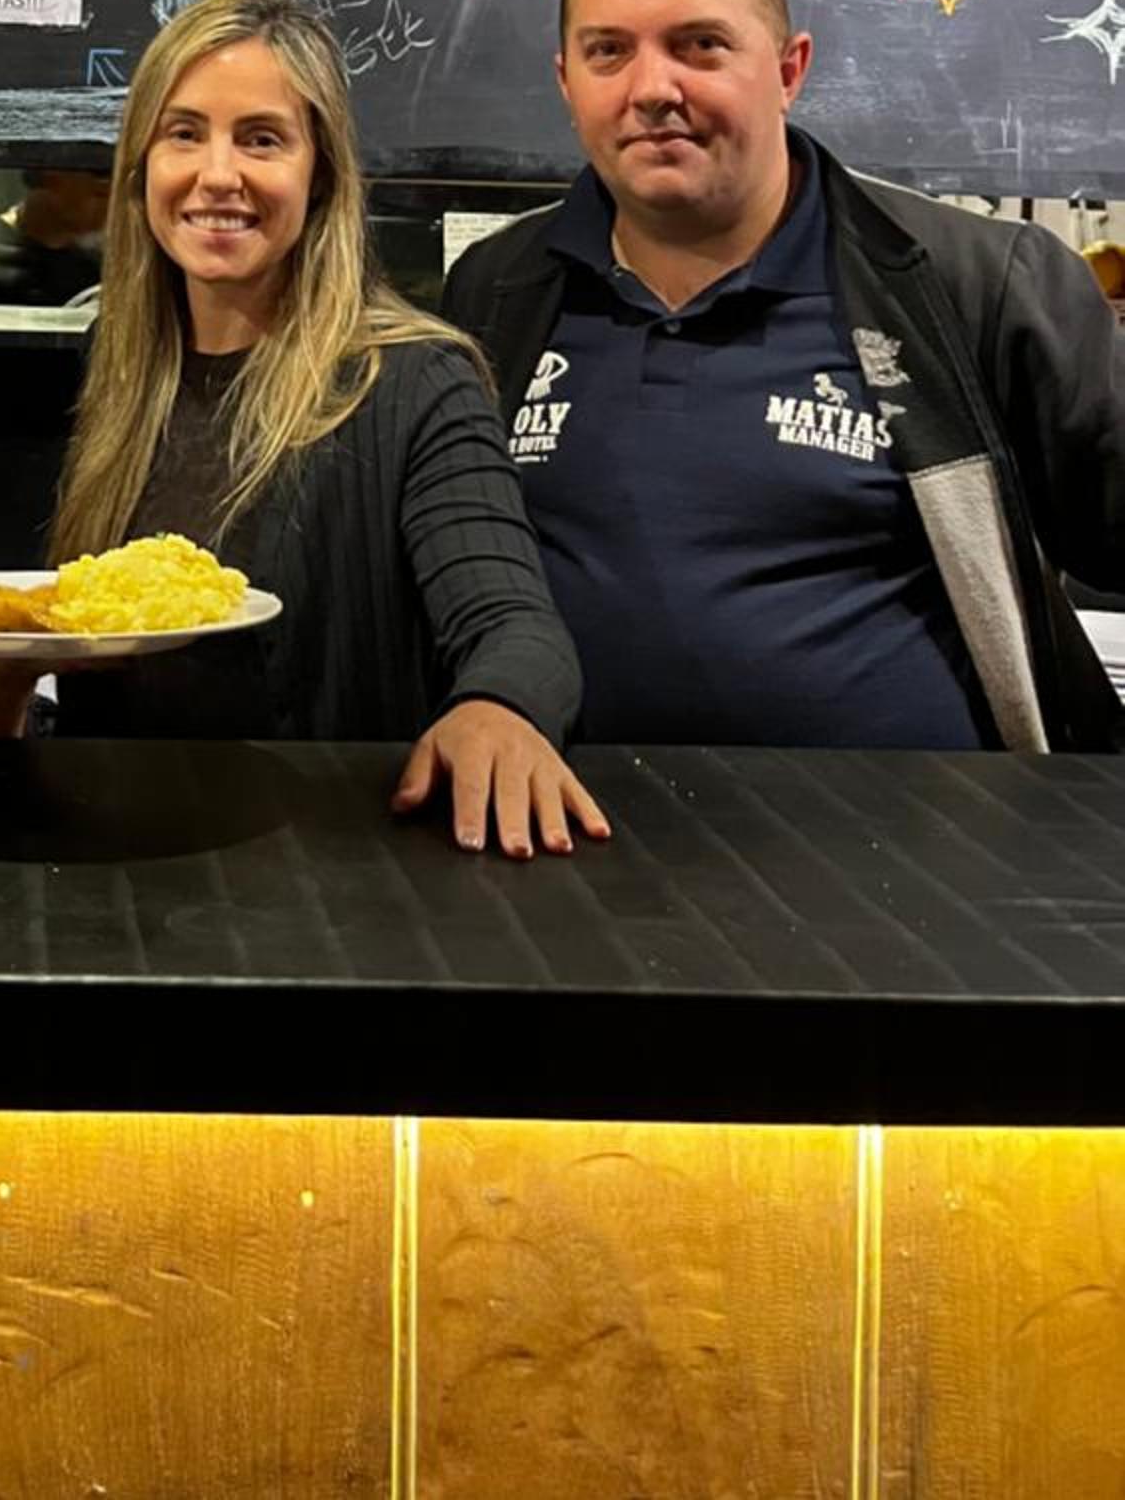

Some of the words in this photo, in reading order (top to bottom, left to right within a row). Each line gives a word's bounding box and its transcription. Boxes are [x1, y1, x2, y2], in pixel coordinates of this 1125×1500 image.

[513, 402, 572, 435] OLY
[764, 394, 894, 449] MATIAS
[778, 422, 875, 462] MANAGER
